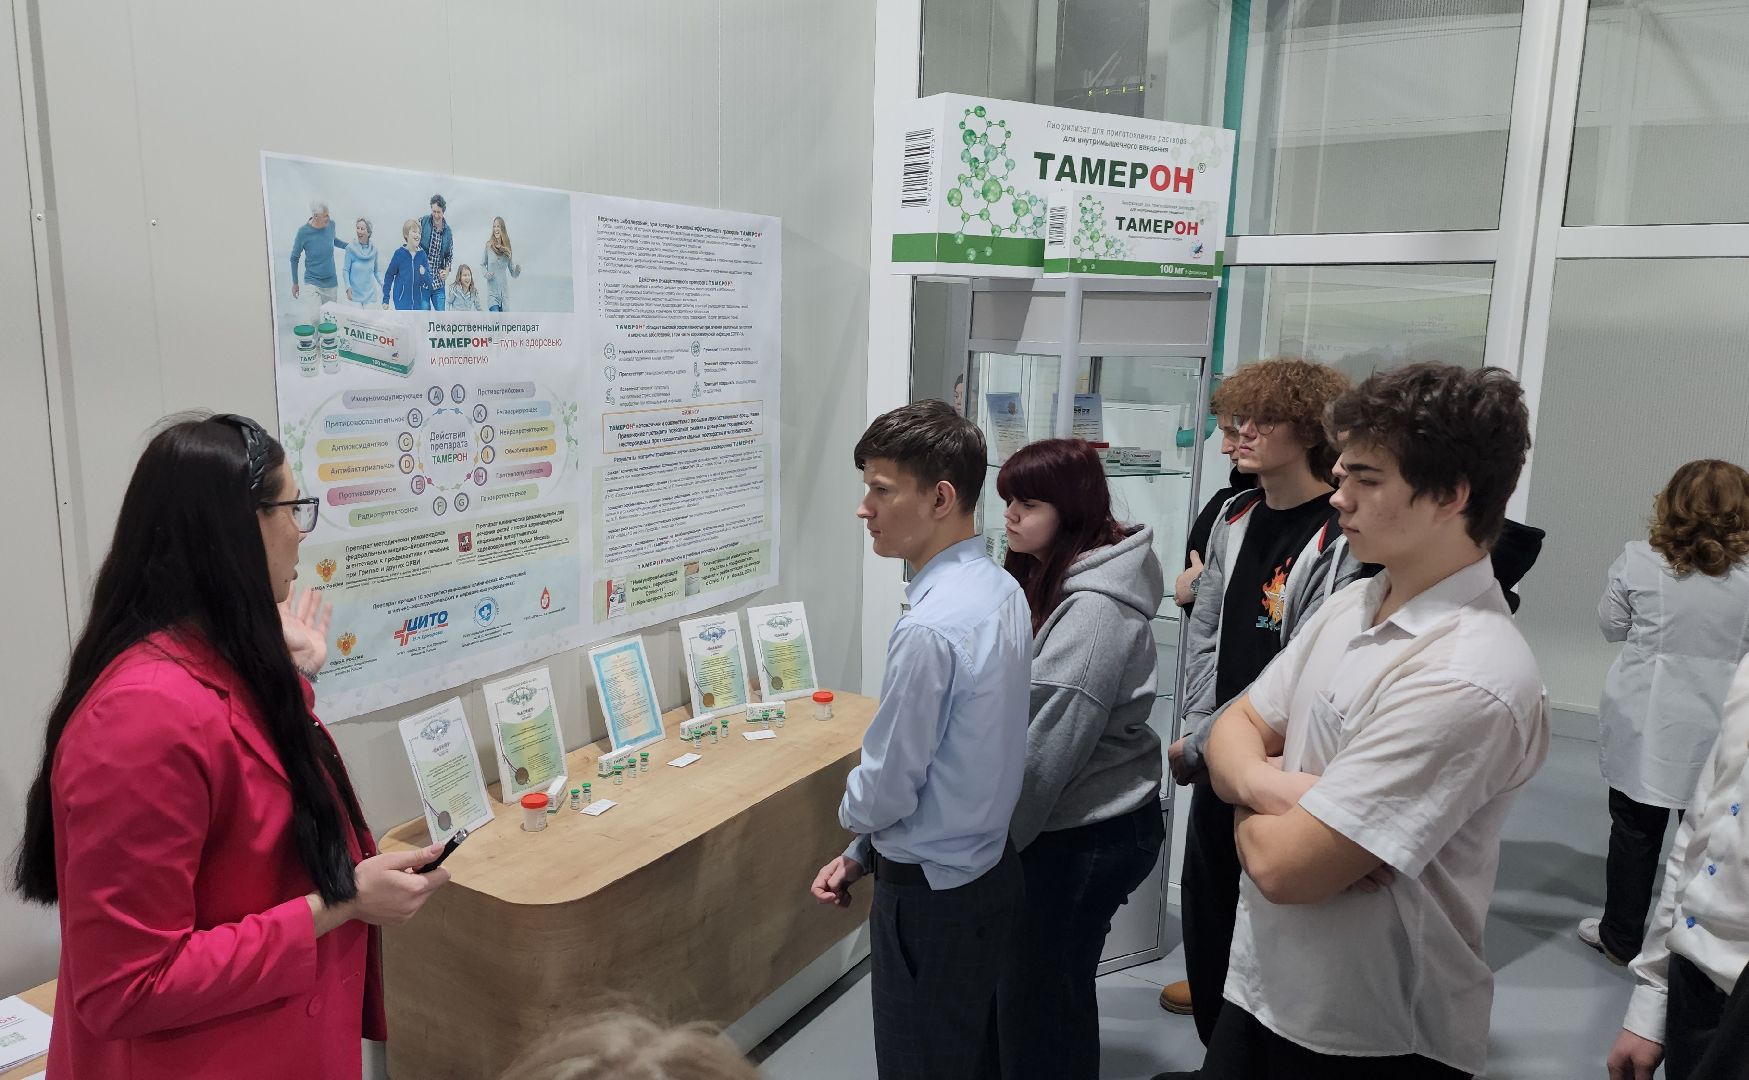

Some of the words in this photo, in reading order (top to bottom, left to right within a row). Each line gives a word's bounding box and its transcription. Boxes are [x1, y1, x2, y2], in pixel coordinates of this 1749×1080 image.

[1160, 264, 1174, 274] 100
[1174, 266, 1185, 274] мг
[428, 321, 500, 335] Лекарственный
[501, 323, 540, 334] препарат
[343, 326, 396, 347] ТАМЕРОН
[500, 338, 518, 350] путь
[519, 339, 524, 347] к
[525, 338, 563, 349] здоровью
[430, 356, 436, 365] и
[438, 355, 489, 367] долголетию
[430, 431, 466, 443] Действия
[430, 441, 468, 452] препарата
[432, 453, 468, 465] ТАМЕРОН
[406, 610, 449, 632] ЦИТО
